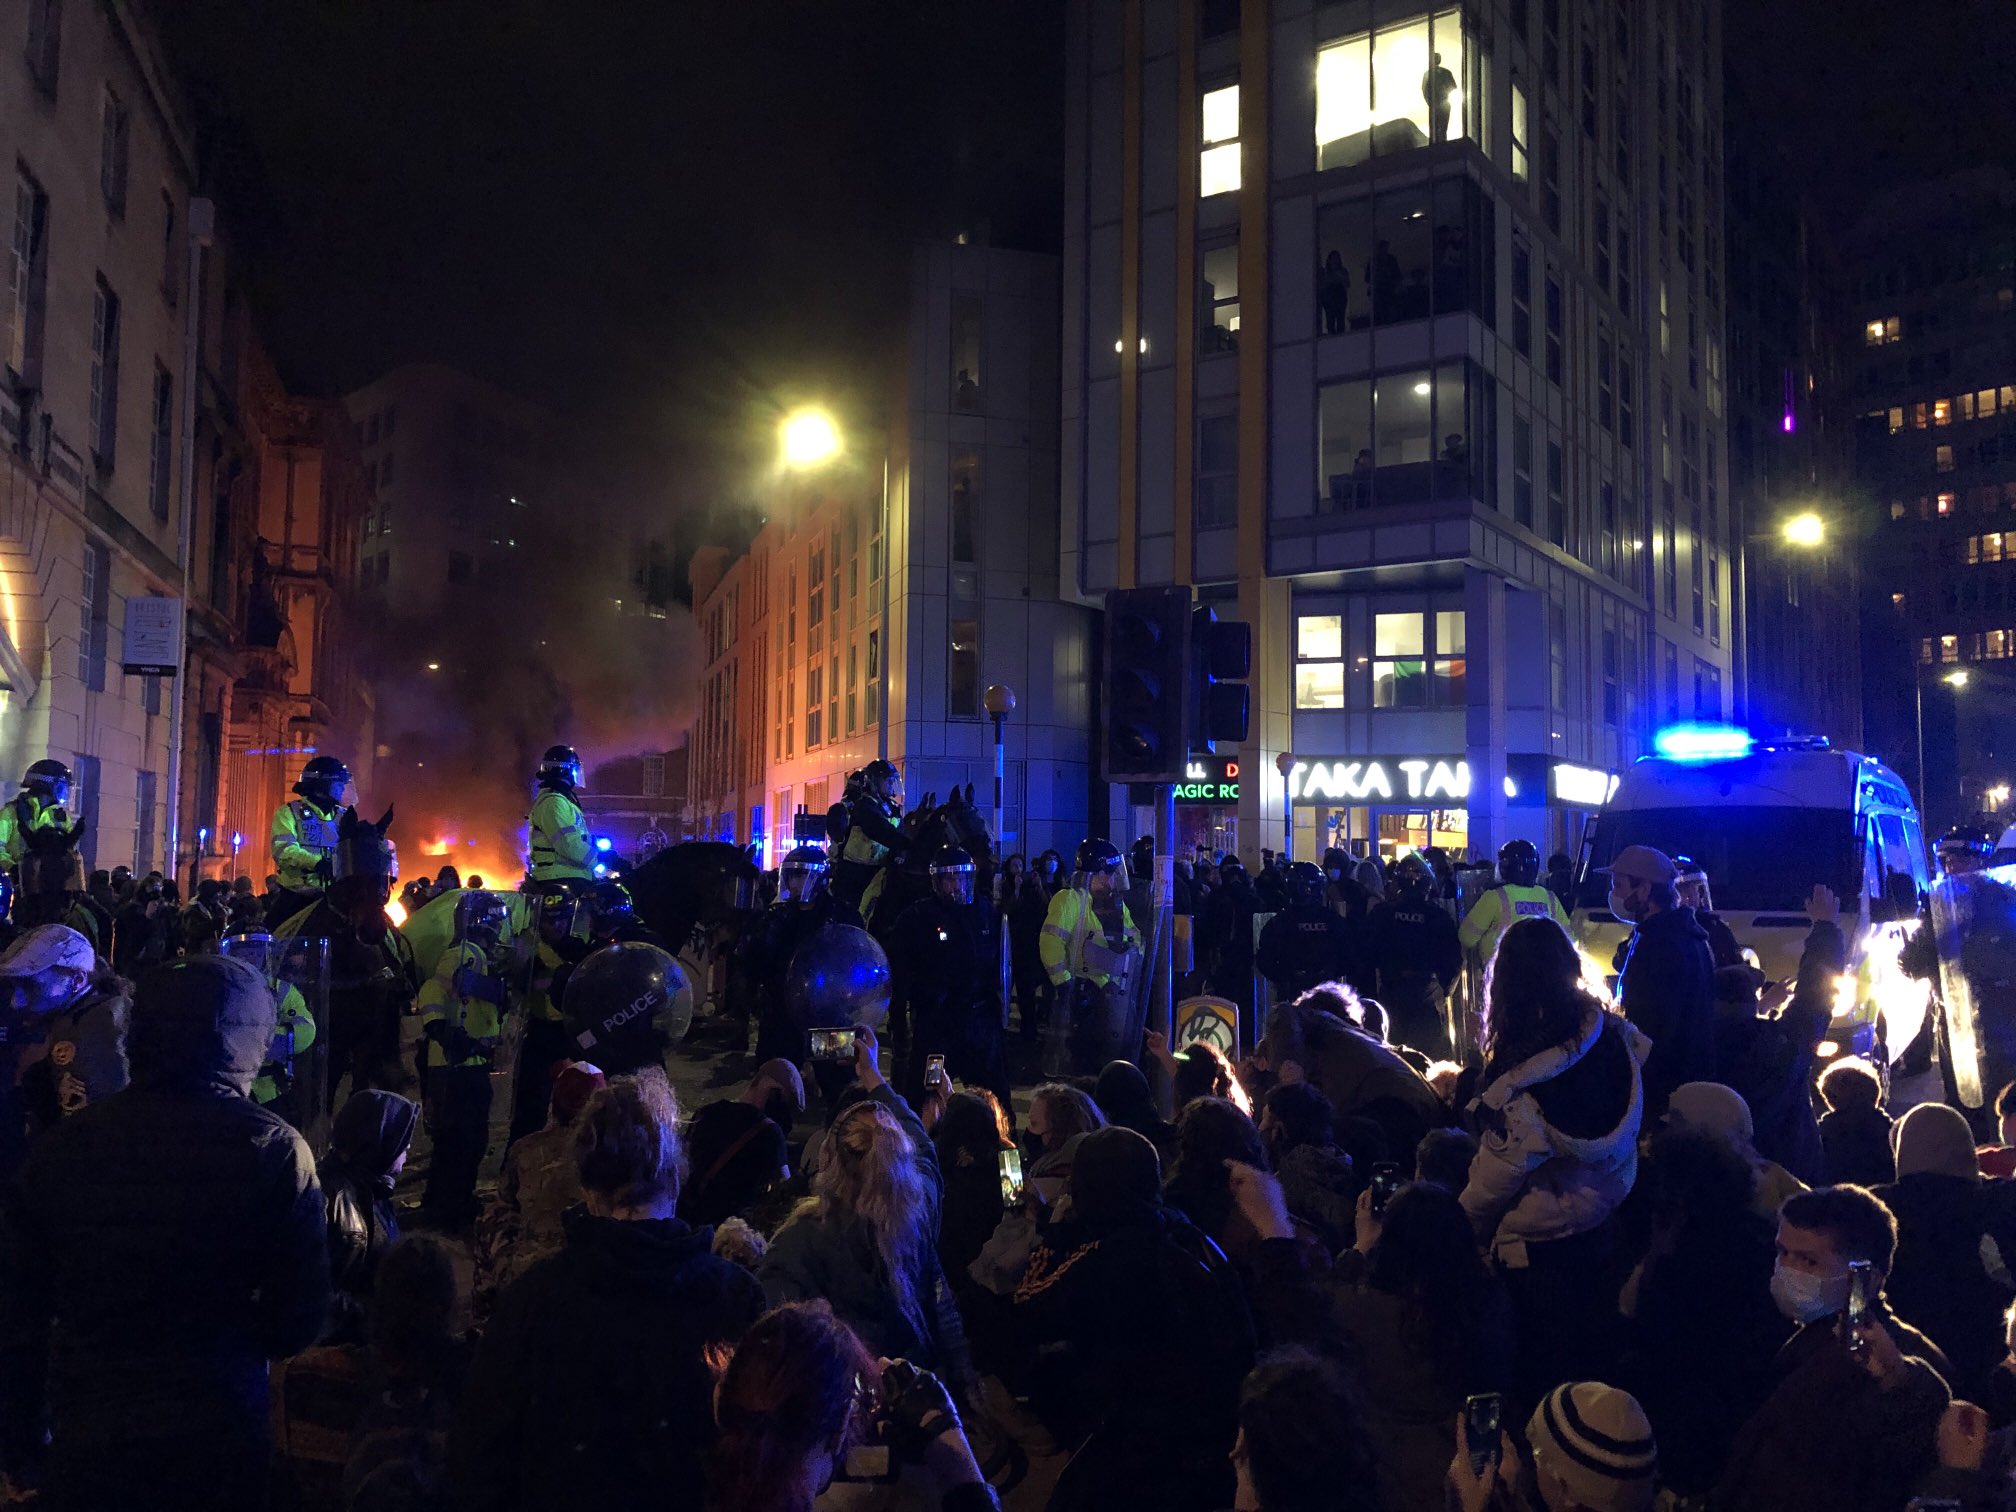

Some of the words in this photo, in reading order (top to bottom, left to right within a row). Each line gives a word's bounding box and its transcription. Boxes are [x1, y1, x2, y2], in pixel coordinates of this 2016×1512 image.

[1516, 901, 1548, 915] POLICE
[1394, 911, 1424, 923] POLICE
[1296, 922, 1328, 932] POLICE
[602, 990, 657, 1032] POLICE
